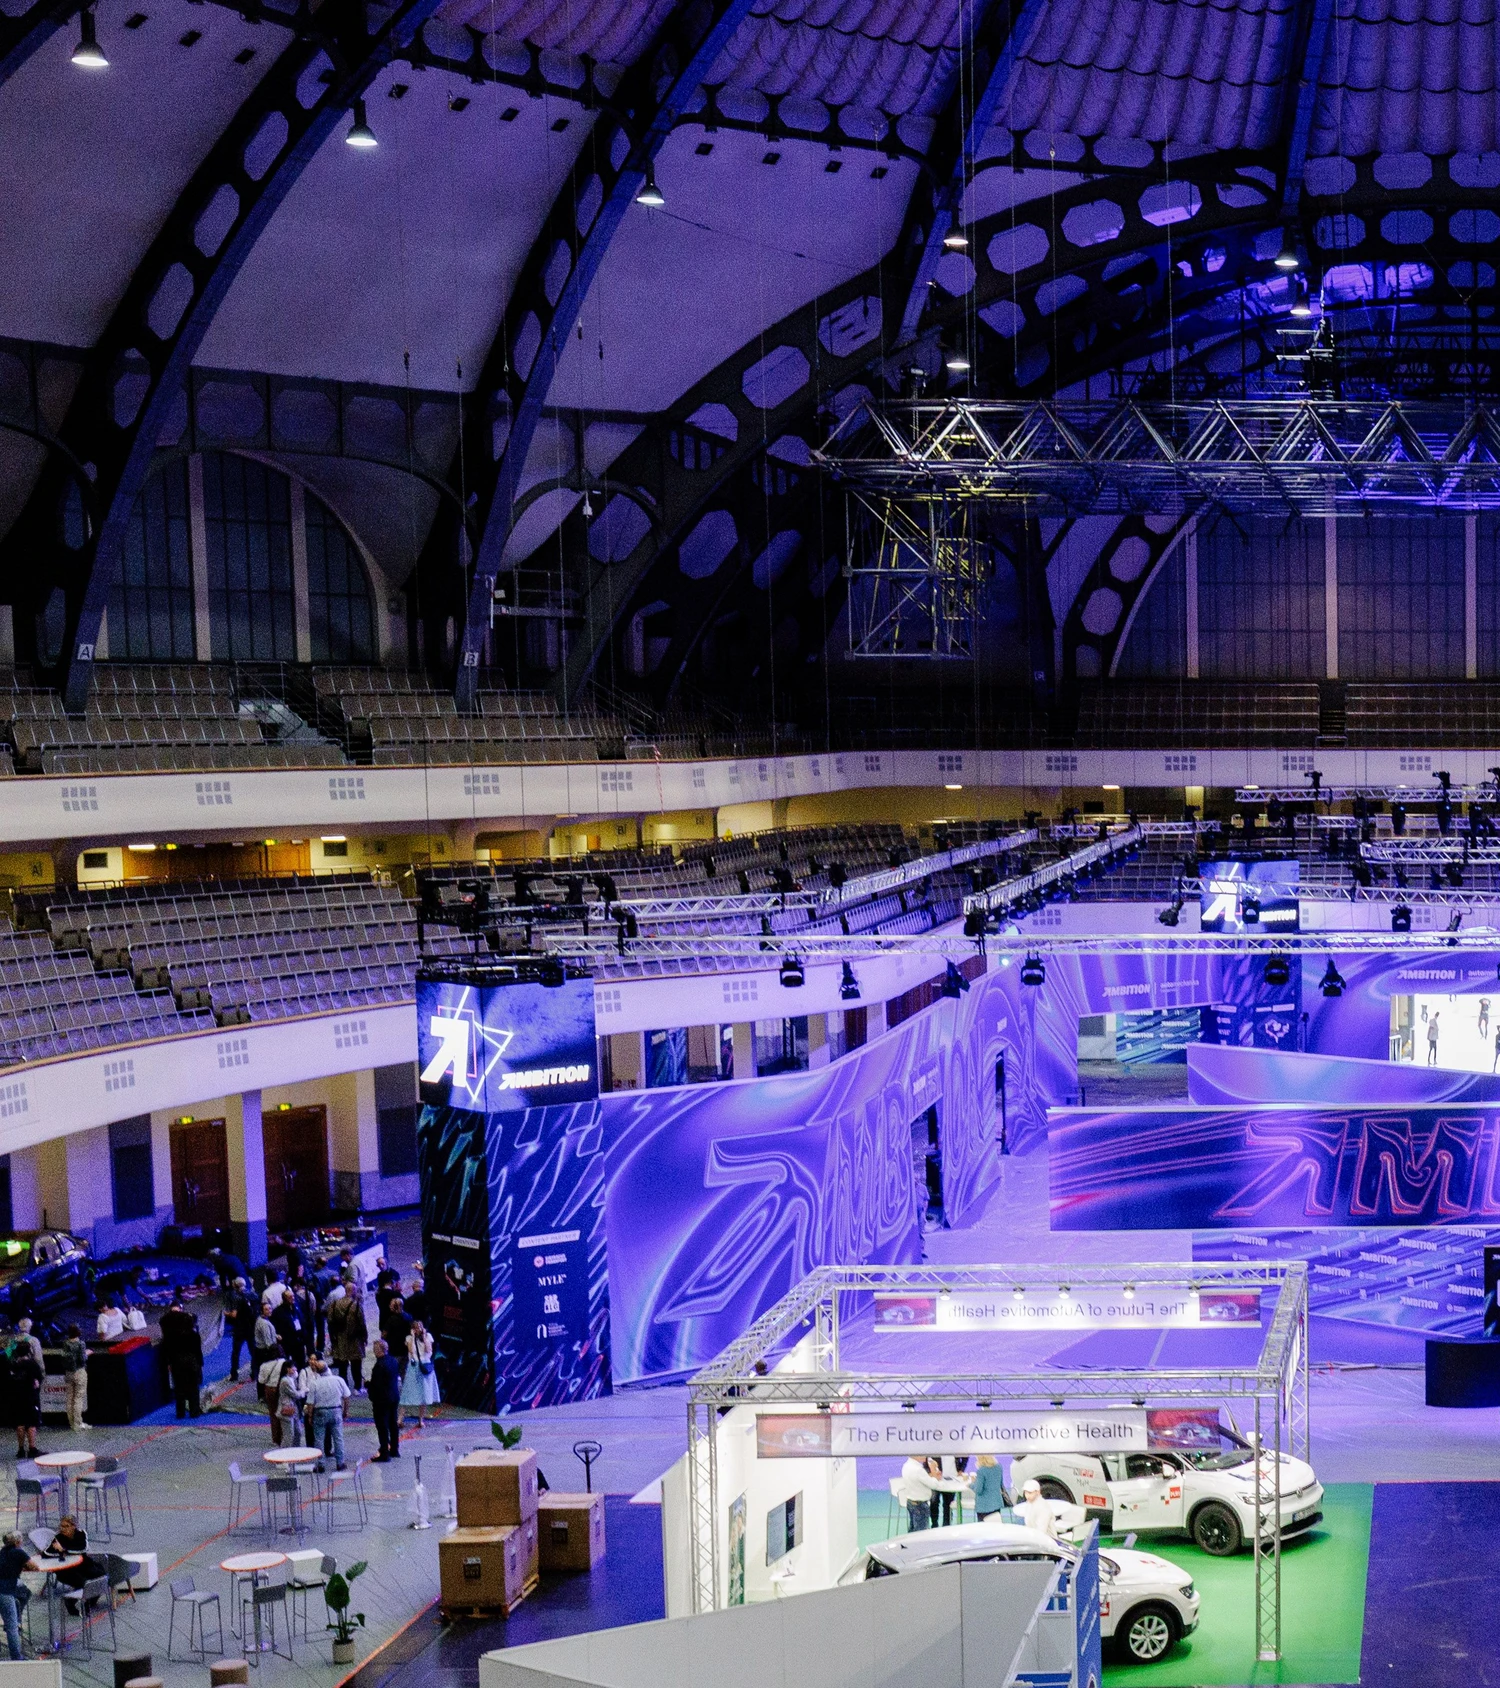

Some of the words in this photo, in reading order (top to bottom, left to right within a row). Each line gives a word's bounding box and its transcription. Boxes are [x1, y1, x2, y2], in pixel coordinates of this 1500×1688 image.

[1396, 969, 1456, 980] AMBITION
[1102, 984, 1151, 997] AMBITION
[498, 1064, 590, 1090] AMBITION
[1233, 1233, 1268, 1247] AMBITION
[1399, 1237, 1438, 1251] AMBITION
[1359, 1251, 1398, 1265] AMBITION
[1313, 1264, 1352, 1278] AMBITION
[1447, 1283, 1485, 1298] AMBITIO
[1400, 1296, 1439, 1310] AMBITION
[845, 1426, 879, 1443] The
[886, 1425, 943, 1443] Future
[949, 1424, 967, 1442] of
[970, 1424, 1071, 1441] Automotive
[1076, 1422, 1134, 1440] Health
